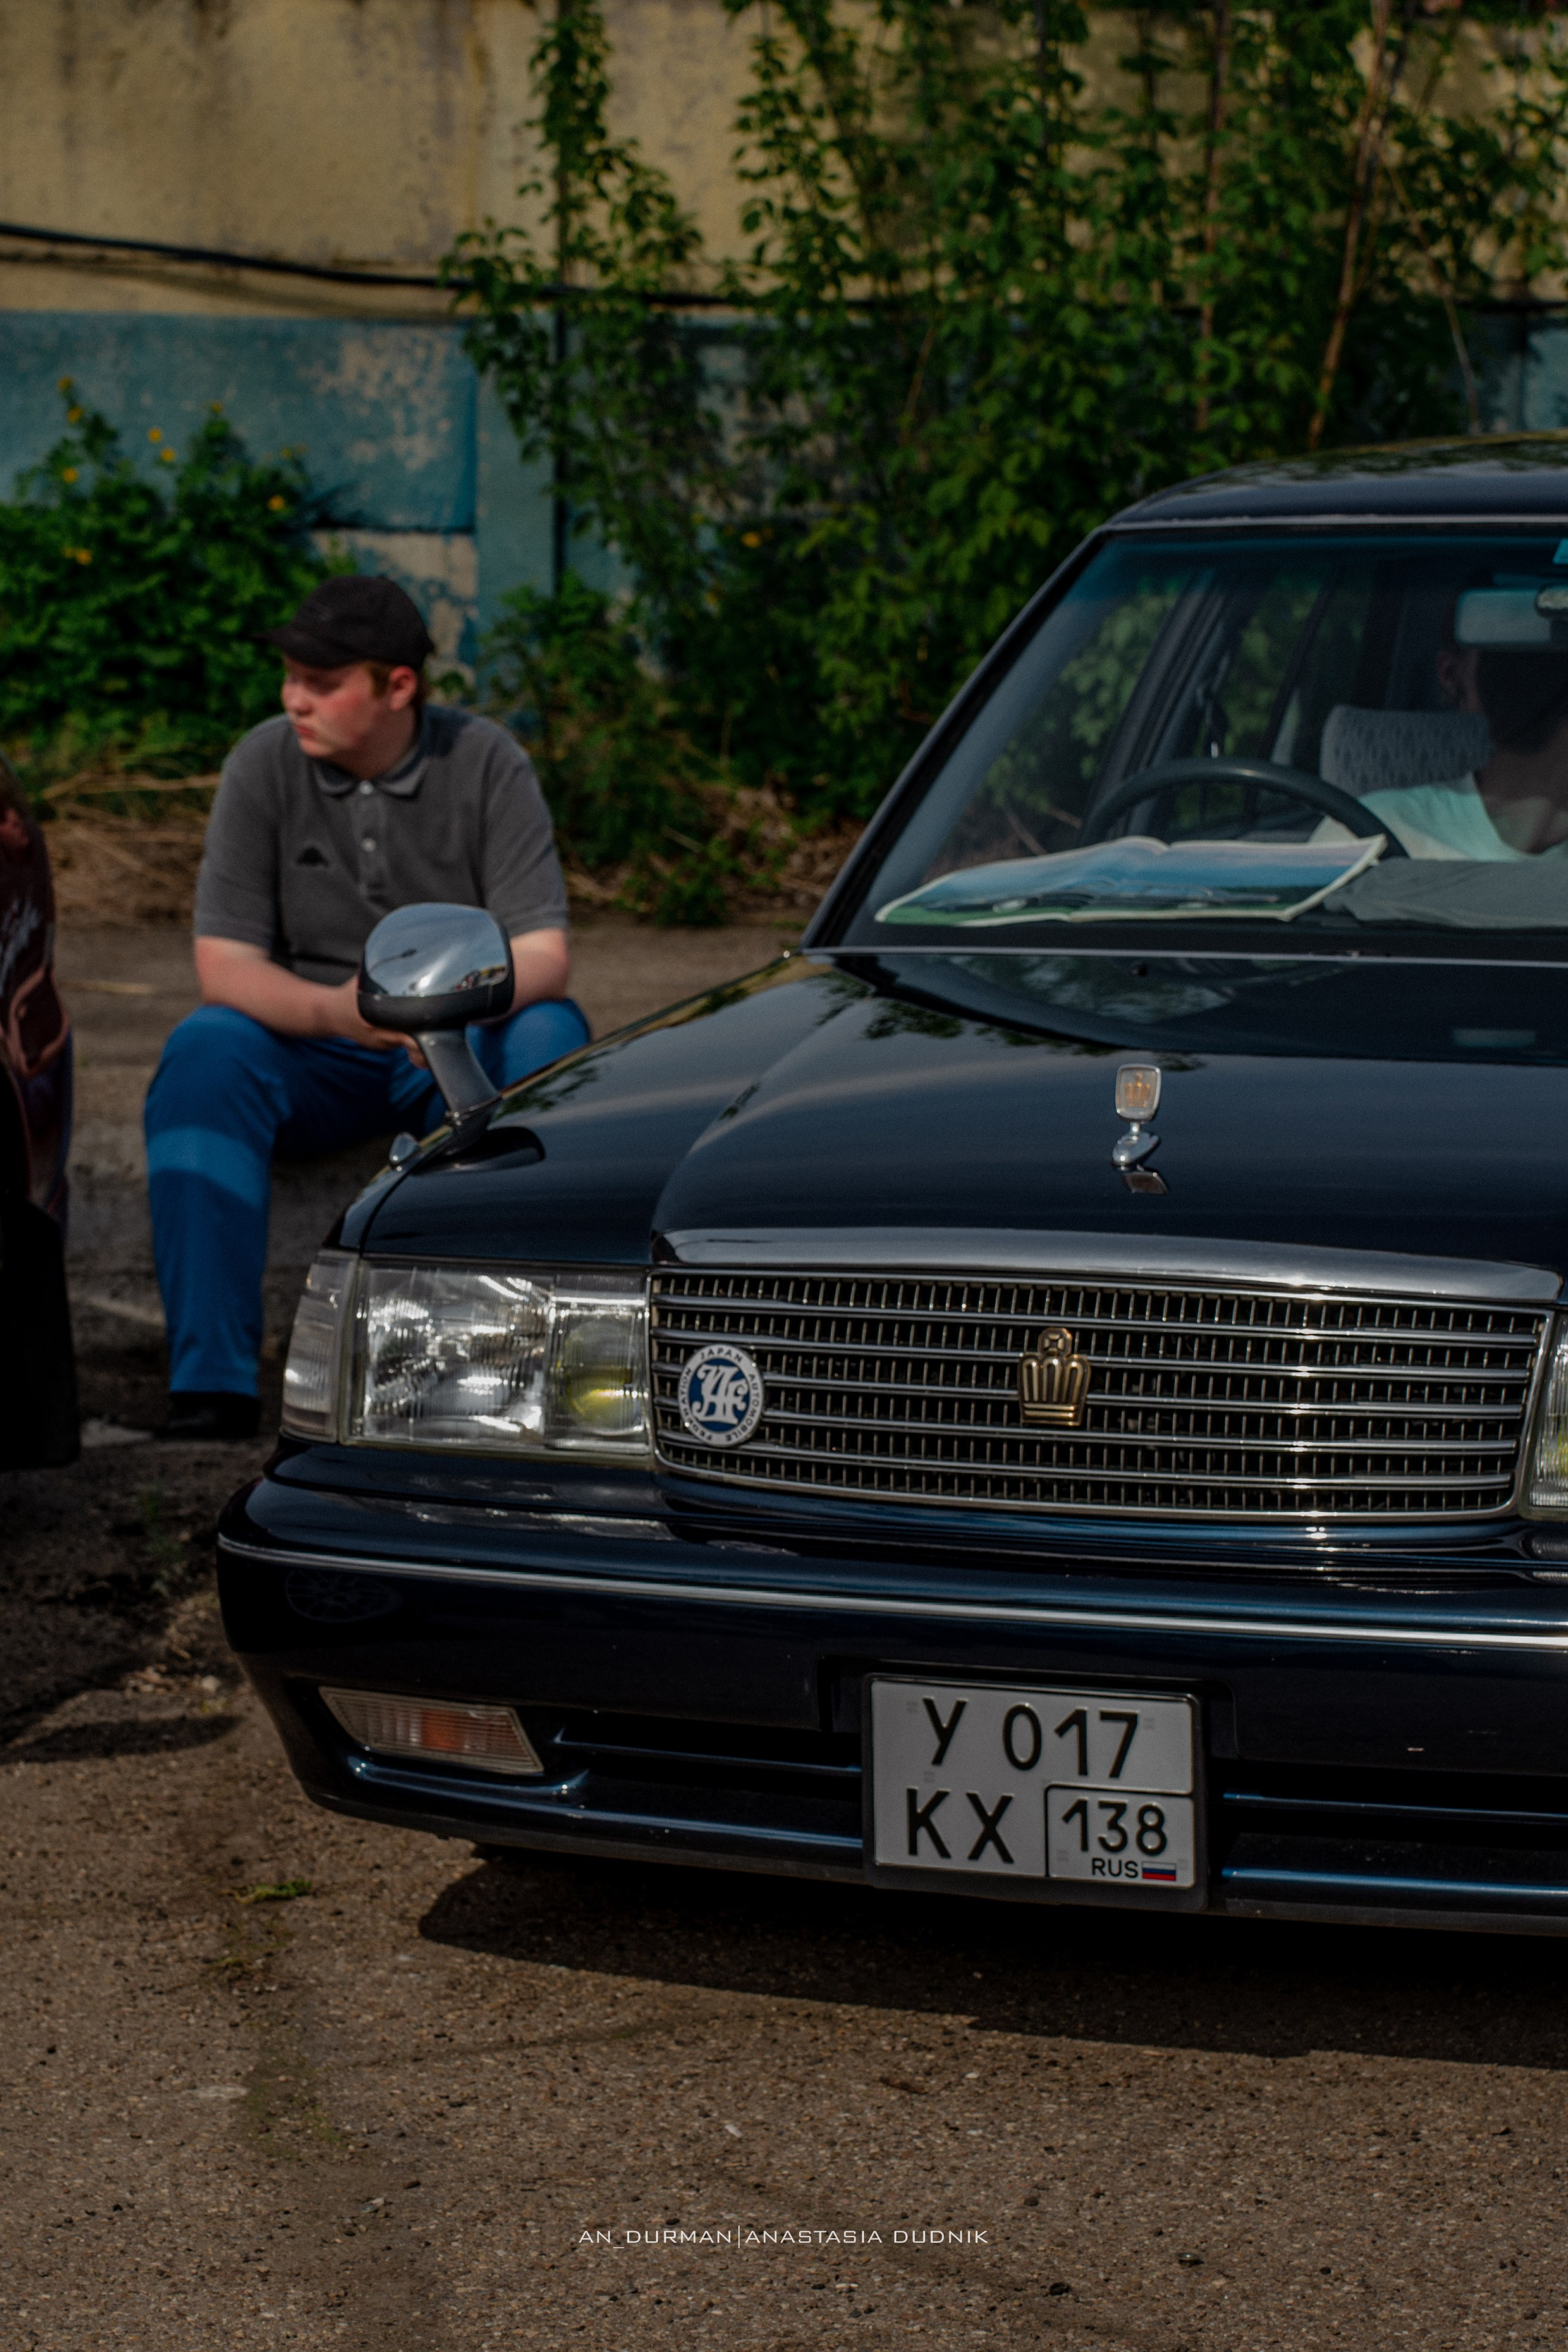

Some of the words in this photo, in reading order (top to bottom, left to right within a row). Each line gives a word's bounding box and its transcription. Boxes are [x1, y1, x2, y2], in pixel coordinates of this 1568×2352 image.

[700, 1348, 743, 1362] JAPAN
[680, 1368, 713, 1441] FEDERATION
[725, 1373, 760, 1441] AUTOMOBILE
[1002, 1703, 1140, 1778] 017
[1061, 1798, 1167, 1856] 138
[1091, 1858, 1139, 1879] RUS
